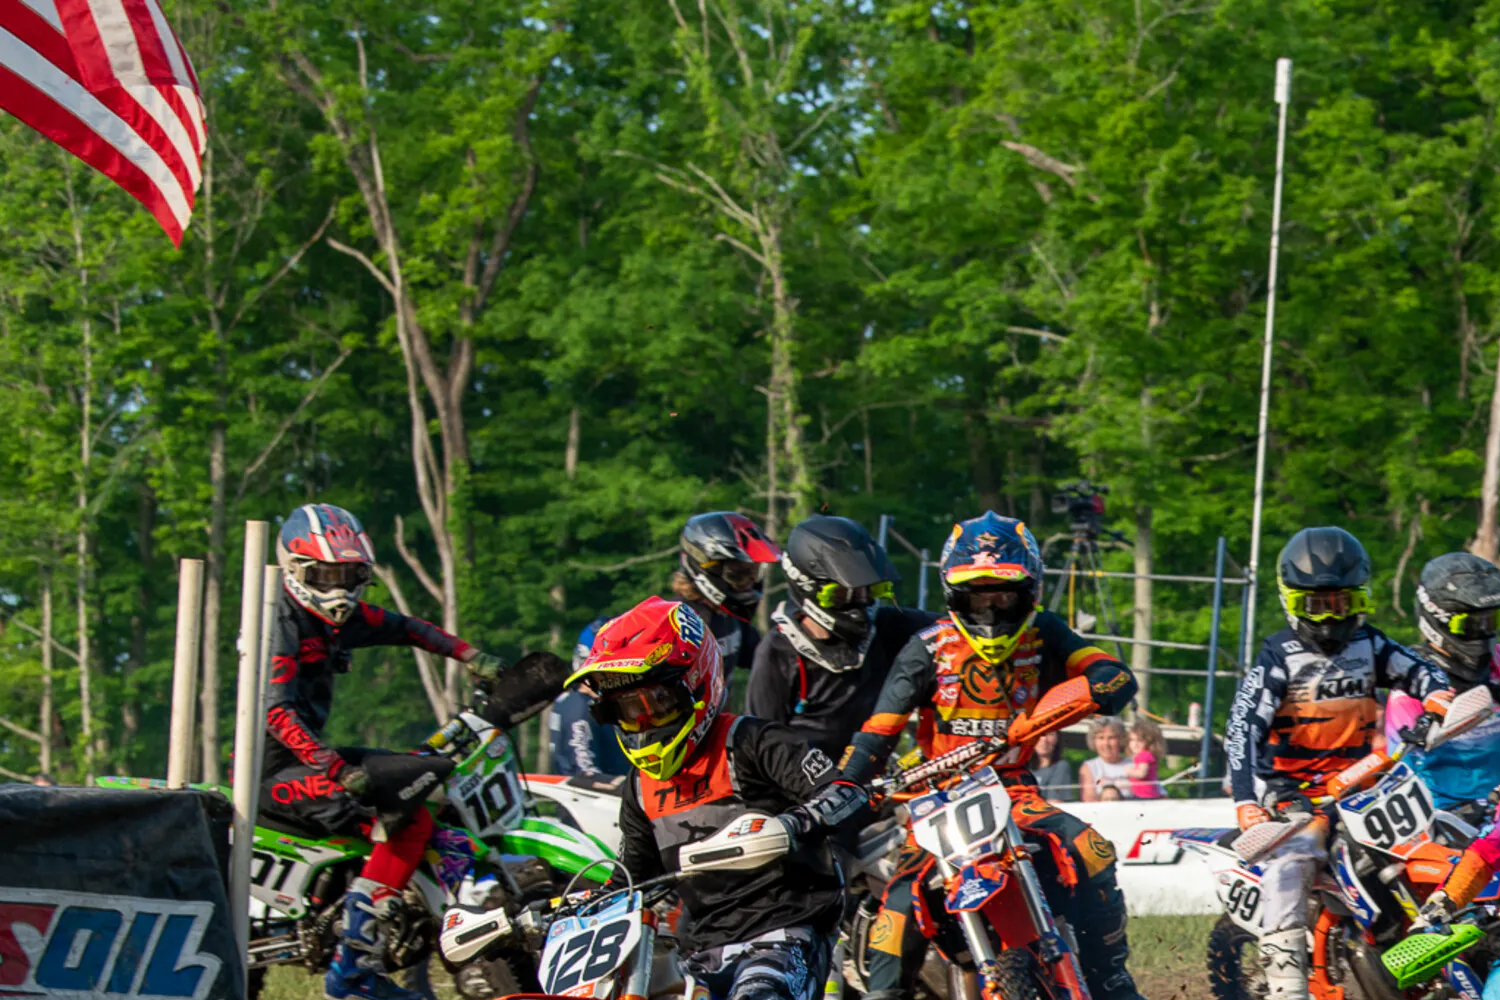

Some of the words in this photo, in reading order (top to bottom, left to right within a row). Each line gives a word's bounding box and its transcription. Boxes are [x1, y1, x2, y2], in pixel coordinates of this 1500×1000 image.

[1316, 677, 1366, 700] KTM
[905, 745, 982, 783] RENTHAL
[654, 774, 710, 812] TLD
[1364, 782, 1433, 850] 991
[929, 791, 997, 859] 10
[1227, 876, 1262, 922] 99
[545, 919, 631, 995] 128
